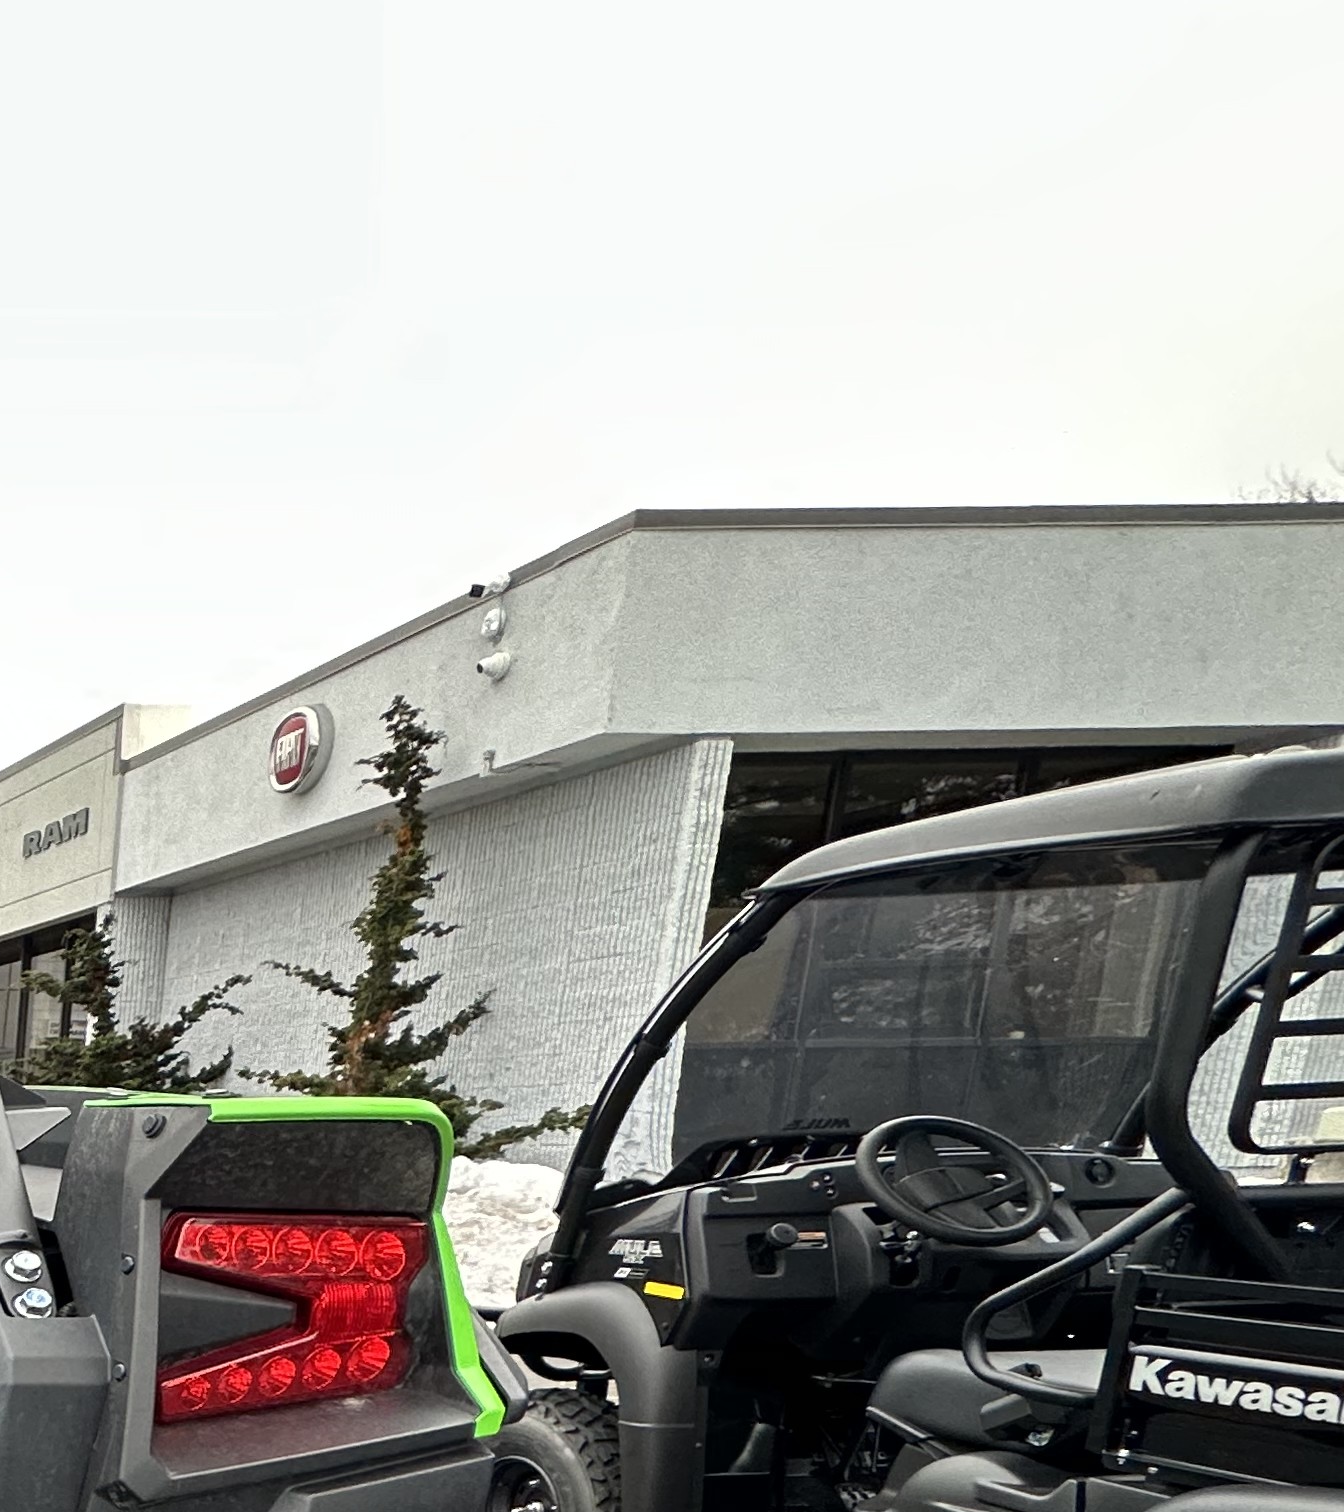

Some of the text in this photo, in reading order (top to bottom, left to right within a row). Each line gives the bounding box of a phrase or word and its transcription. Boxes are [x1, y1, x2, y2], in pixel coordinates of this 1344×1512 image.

[22, 807, 90, 860] RAM
[608, 1238, 664, 1257] MULE
[1128, 1354, 1344, 1425] Kawasa
